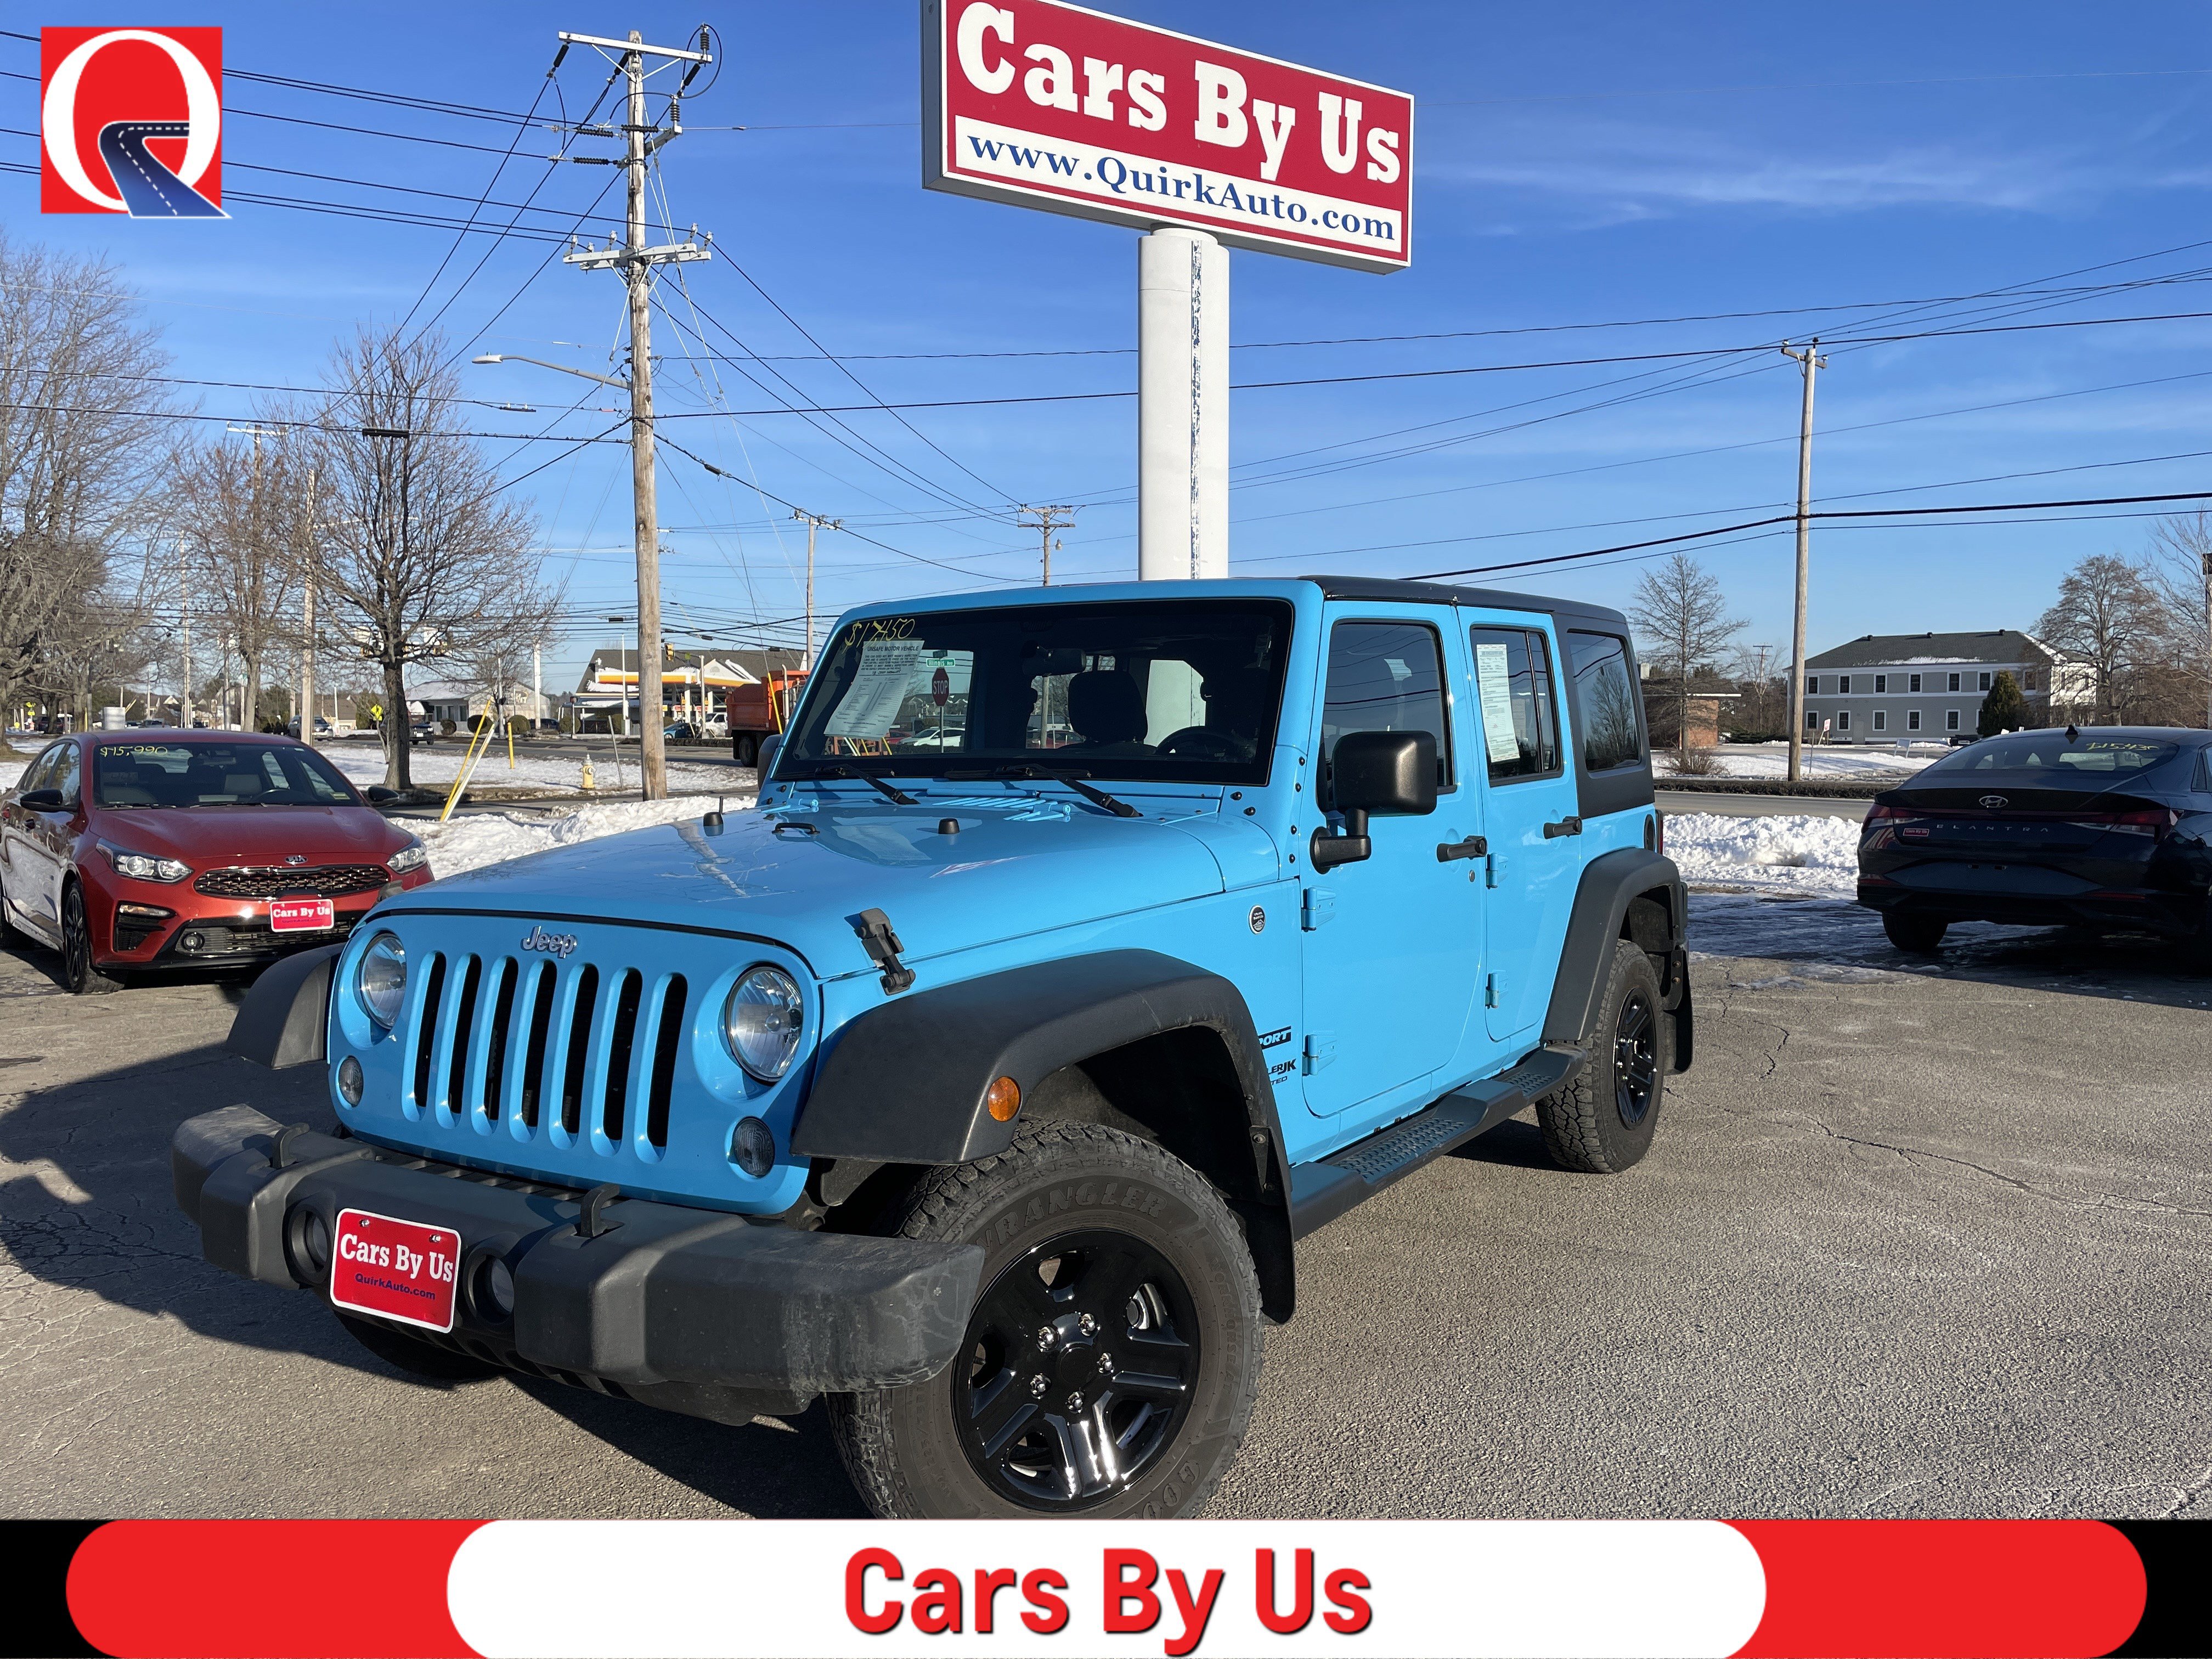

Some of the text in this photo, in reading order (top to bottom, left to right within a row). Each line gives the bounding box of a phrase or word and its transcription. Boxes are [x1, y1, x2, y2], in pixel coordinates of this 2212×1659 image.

[956, 0, 1401, 184] Cars By Us
[967, 134, 1395, 240] www.QuirkAuto.com
[933, 680, 949, 695] STOP
[100, 746, 168, 758] $15,990
[1936, 824, 2049, 832] ELANTRA
[273, 906, 331, 918] Cars By Us
[521, 926, 577, 959] Jeep
[340, 1233, 454, 1283] Cars By Us
[355, 1273, 436, 1301] QuirkAuto.com
